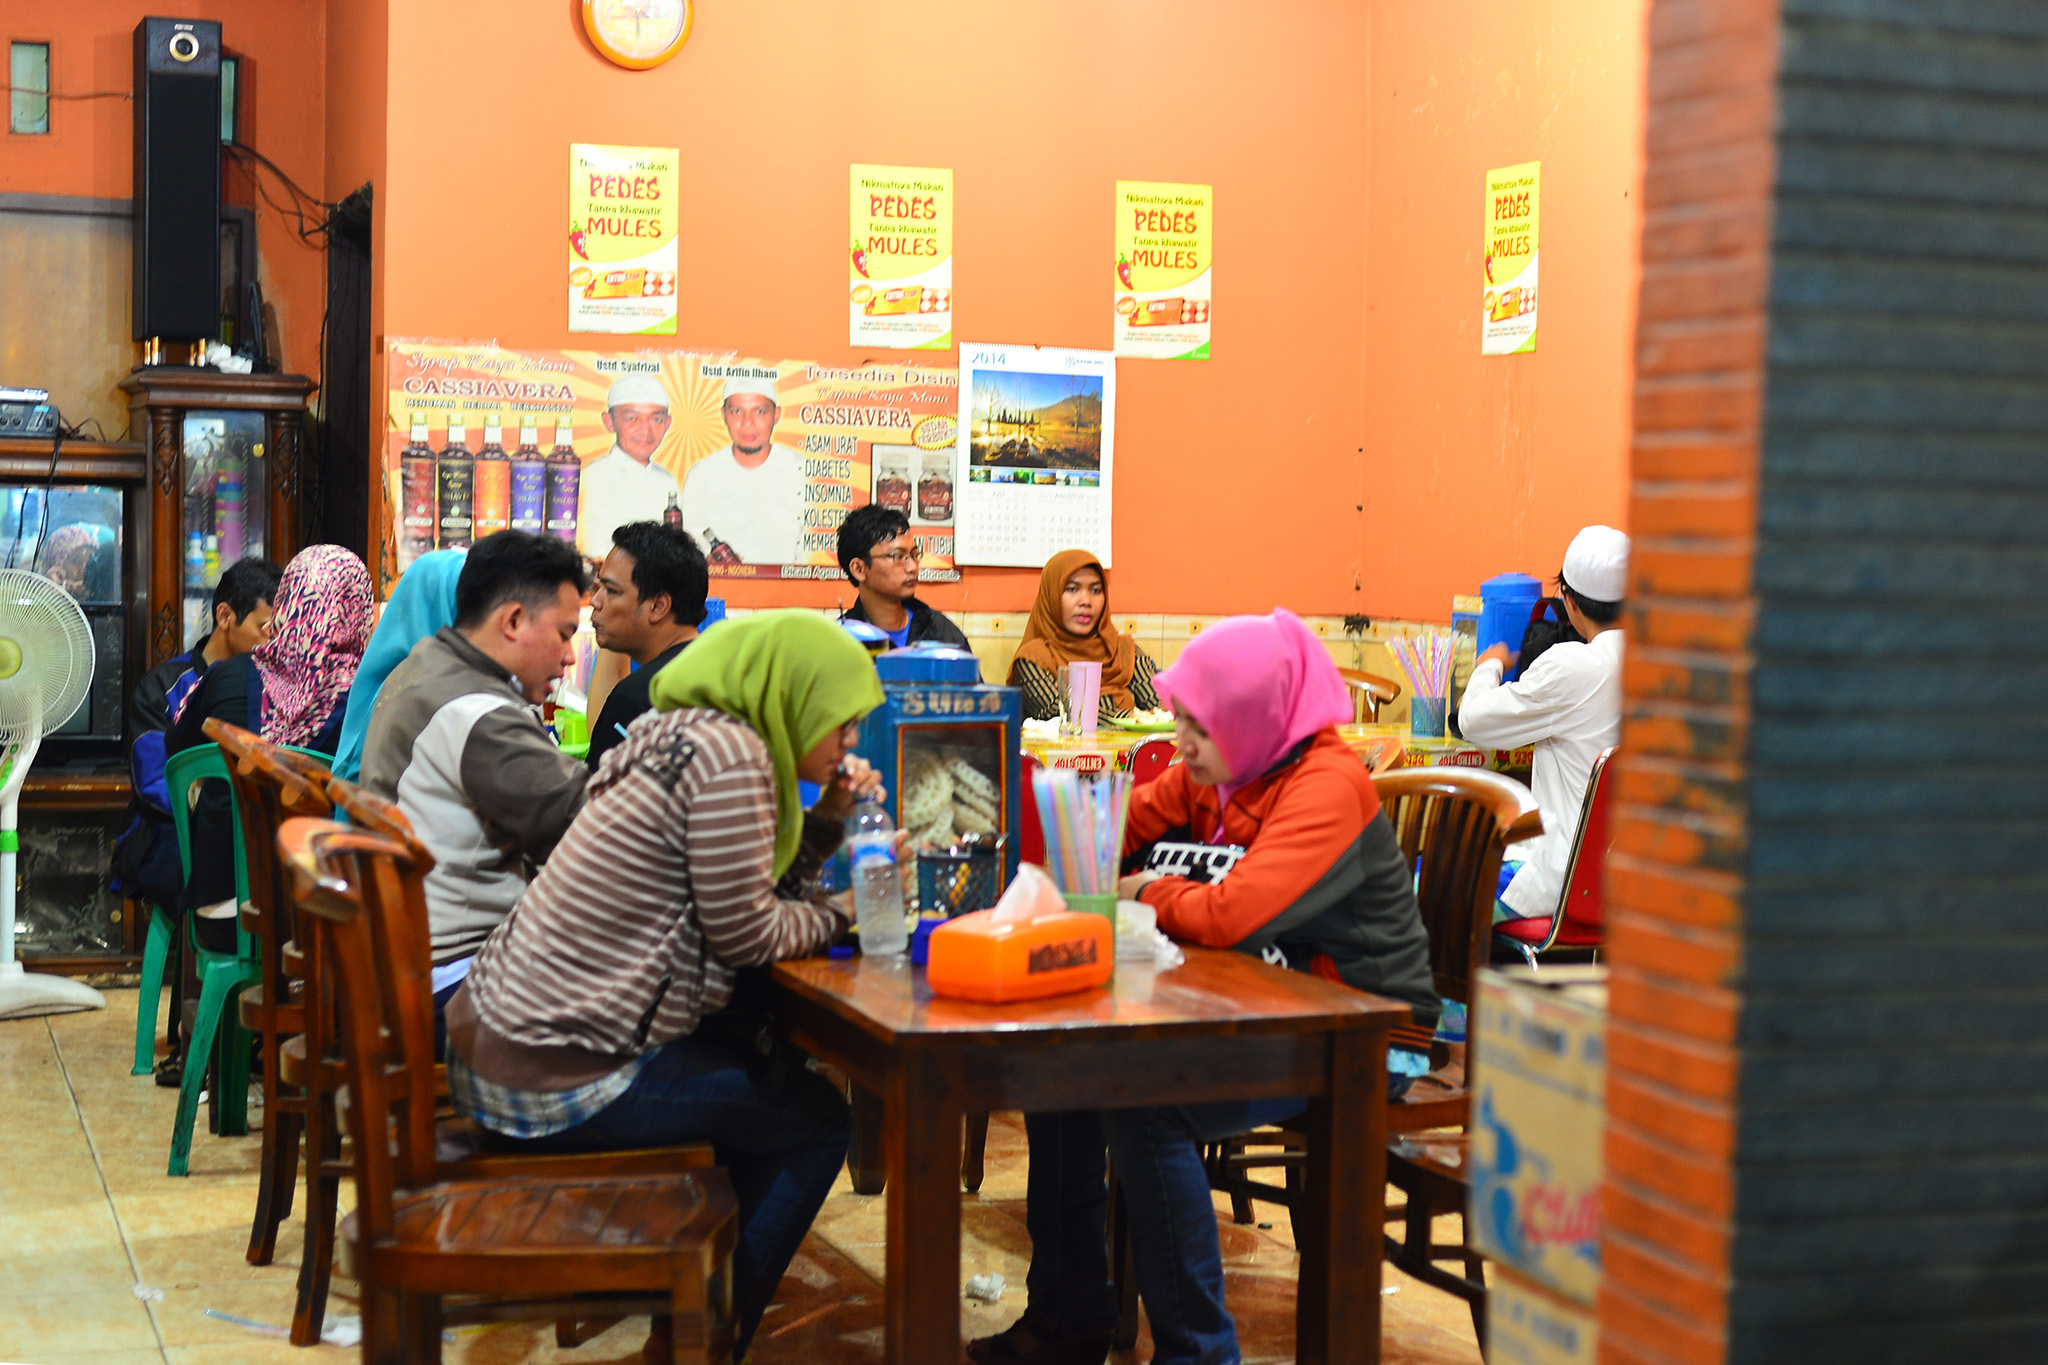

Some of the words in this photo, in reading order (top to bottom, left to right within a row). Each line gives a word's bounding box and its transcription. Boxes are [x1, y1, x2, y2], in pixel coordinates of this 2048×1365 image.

[589, 173, 660, 200] PEDES
[870, 193, 936, 220] PEDES
[1495, 191, 1531, 221] PEDES
[587, 217, 662, 238] MULES
[1134, 208, 1197, 234] PEDES
[868, 236, 937, 257] MULES
[1493, 235, 1530, 259] MULES
[1133, 250, 1198, 270] MULES
[406, 352, 460, 376] Syrup
[465, 353, 515, 378] Kayu
[972, 352, 1006, 365] 2014
[803, 363, 895, 384] Tersedia
[905, 370, 958, 387] Disin
[403, 377, 576, 401] CASSIAVERA
[801, 405, 912, 428] CASSIAVERA
[805, 435, 831, 454] ASAM
[833, 437, 858, 455] URAT
[805, 460, 851, 479] DIABETES
[804, 484, 852, 504] INSOMNIA
